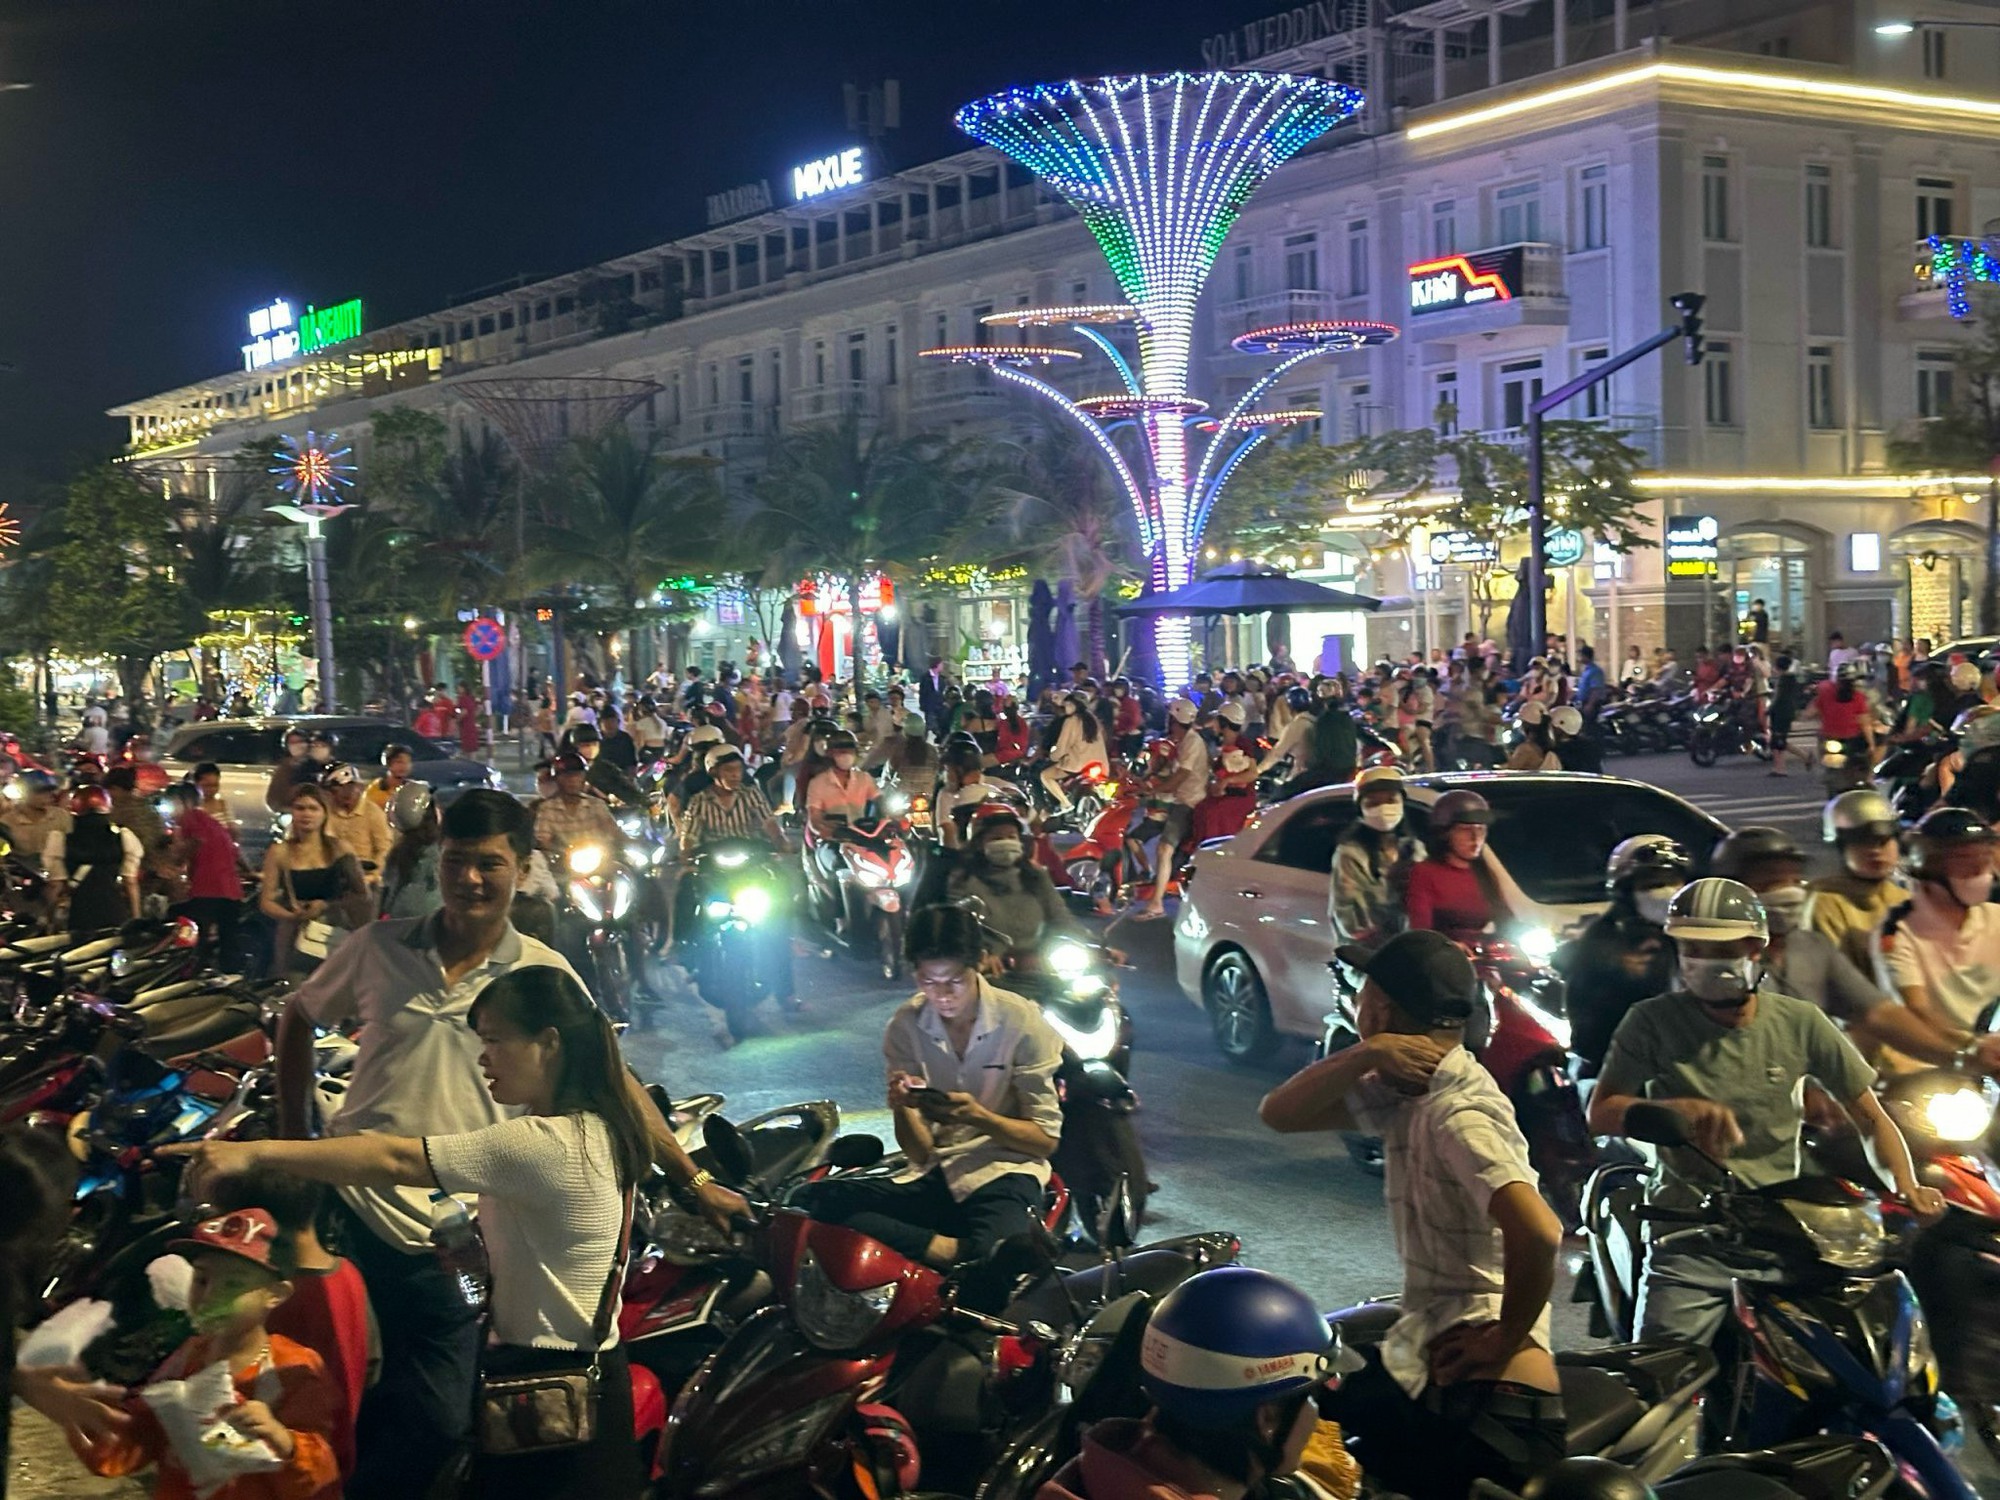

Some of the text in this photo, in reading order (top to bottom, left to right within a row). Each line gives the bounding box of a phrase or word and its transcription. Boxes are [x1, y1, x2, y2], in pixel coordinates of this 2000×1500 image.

[1243, 0, 1347, 59] WEDDING
[793, 146, 863, 200] MIXUE
[1256, 1356, 1296, 1376] YAMAHA
